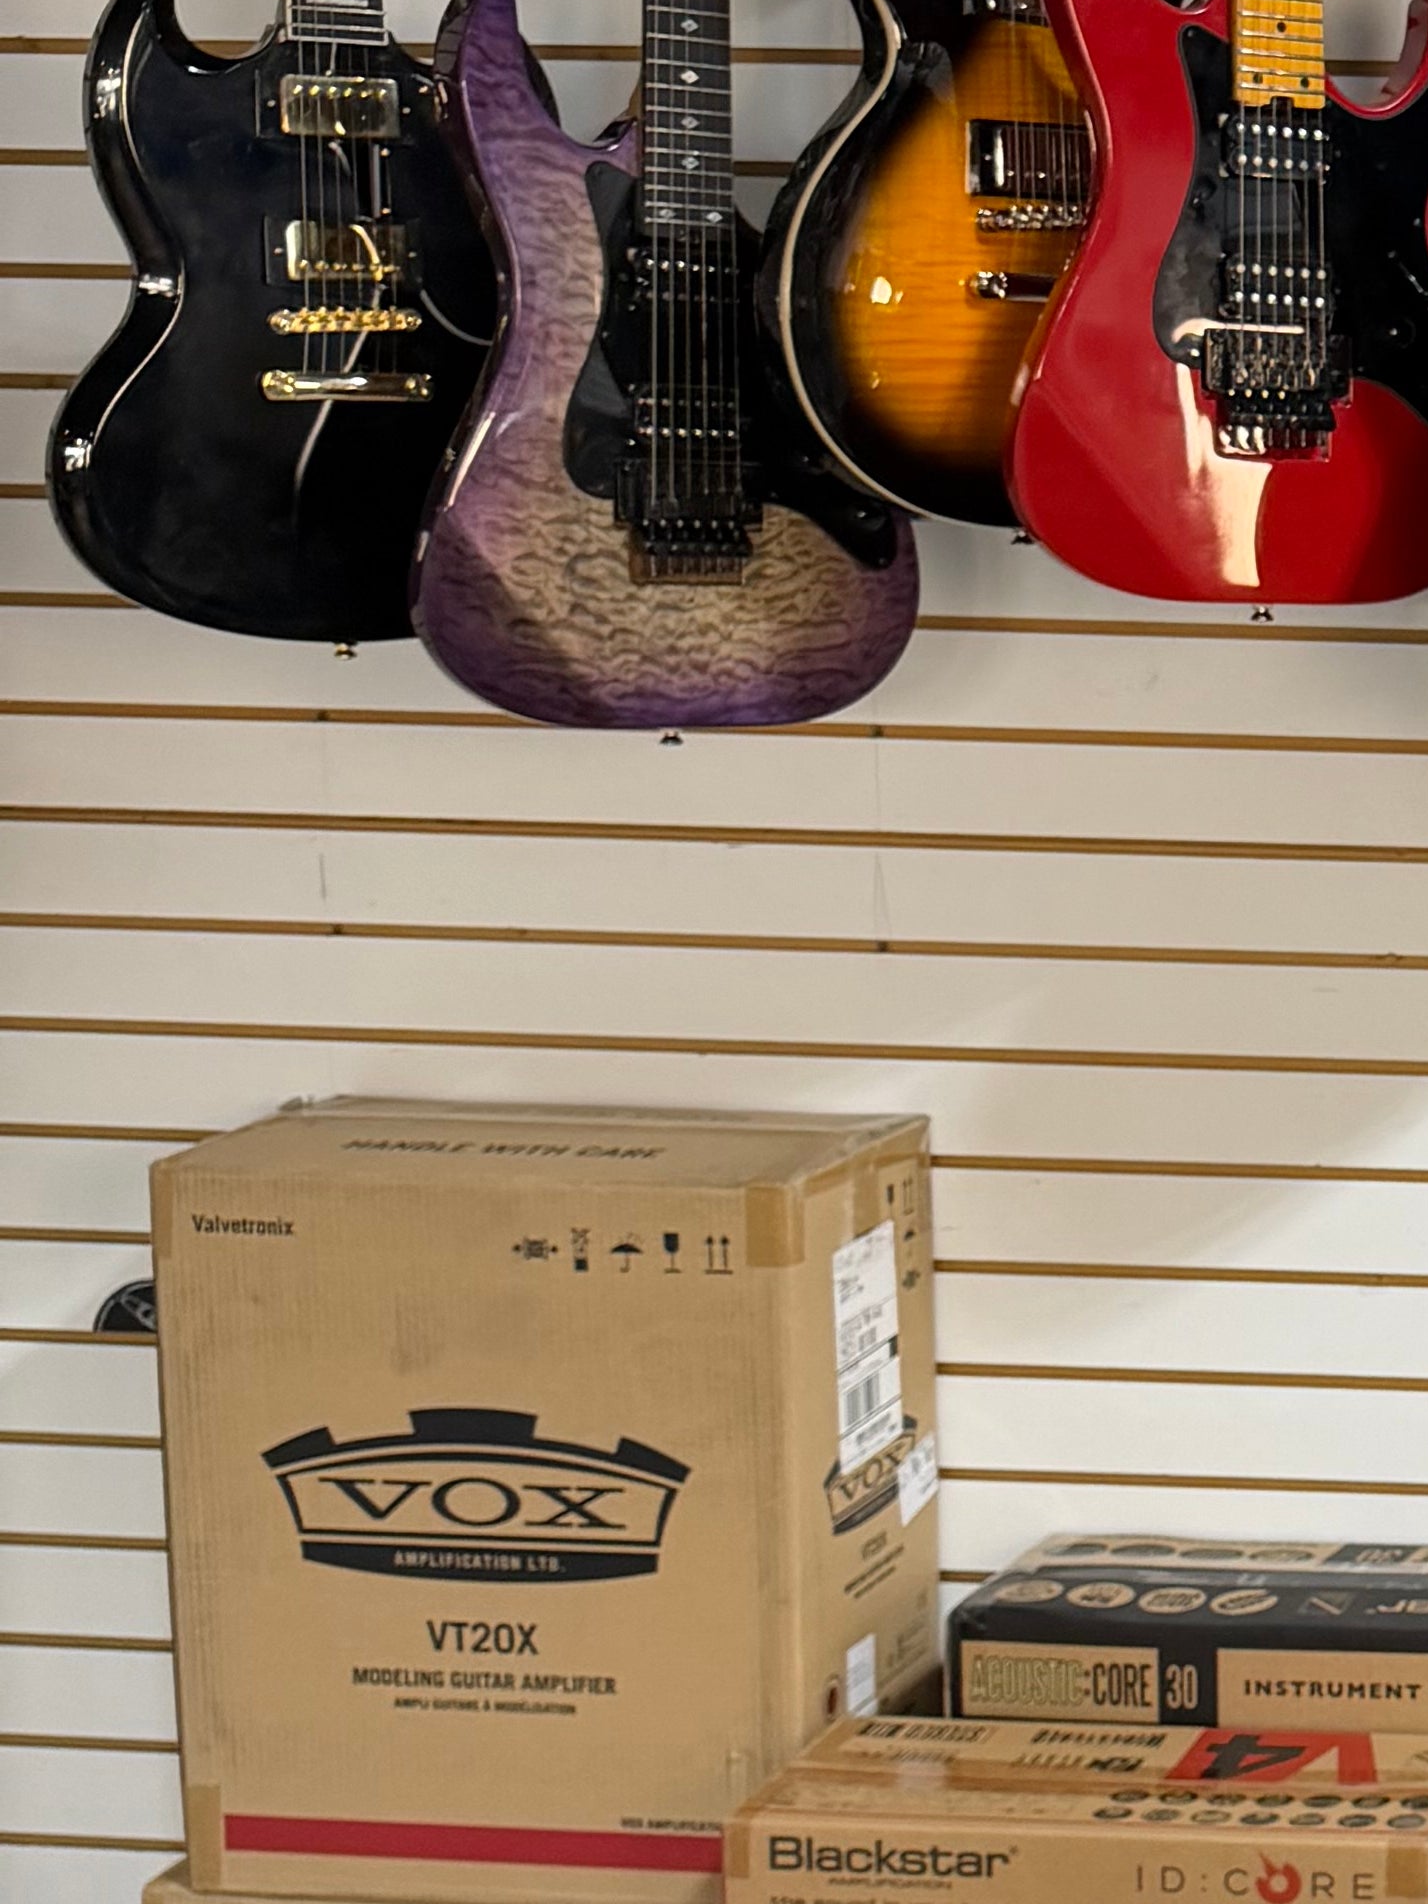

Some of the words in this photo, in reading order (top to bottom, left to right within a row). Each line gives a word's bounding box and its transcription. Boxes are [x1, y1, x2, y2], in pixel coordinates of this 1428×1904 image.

[191, 1211, 295, 1239] Valvetronix
[318, 1475, 628, 1531] VOX
[394, 1550, 522, 1572] AMPLIFICATION
[426, 1619, 540, 1656] VT20X
[352, 1666, 446, 1690] MODELING
[450, 1671, 516, 1691] GUITAR
[520, 1673, 618, 1696] AMPLIFIER
[1165, 1662, 1199, 1711] 30
[1244, 1678, 1421, 1703] INSTRUMENT
[1167, 1730, 1380, 1784] V4
[769, 1835, 1010, 1879] Blackstar
